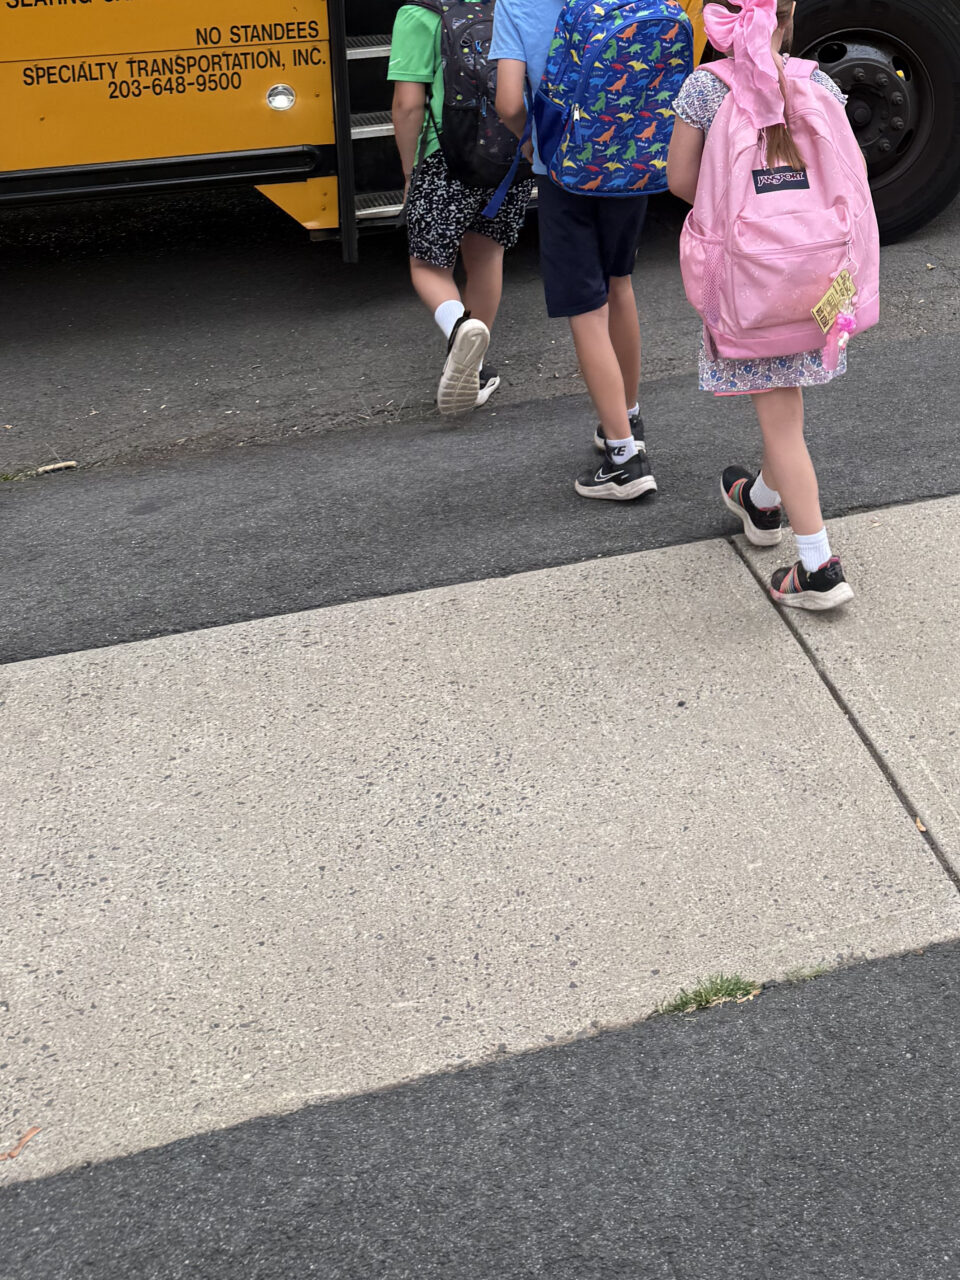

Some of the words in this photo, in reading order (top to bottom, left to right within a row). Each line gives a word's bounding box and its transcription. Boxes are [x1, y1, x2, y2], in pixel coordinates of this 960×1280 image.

[196, 26, 221, 45] NO
[230, 20, 319, 43] STANDEES
[23, 61, 118, 86] SPECIALTY
[126, 49, 285, 78] TRANSPORTATION,
[293, 47, 326, 66] INC.
[108, 72, 242, 99] 203-648-9500
